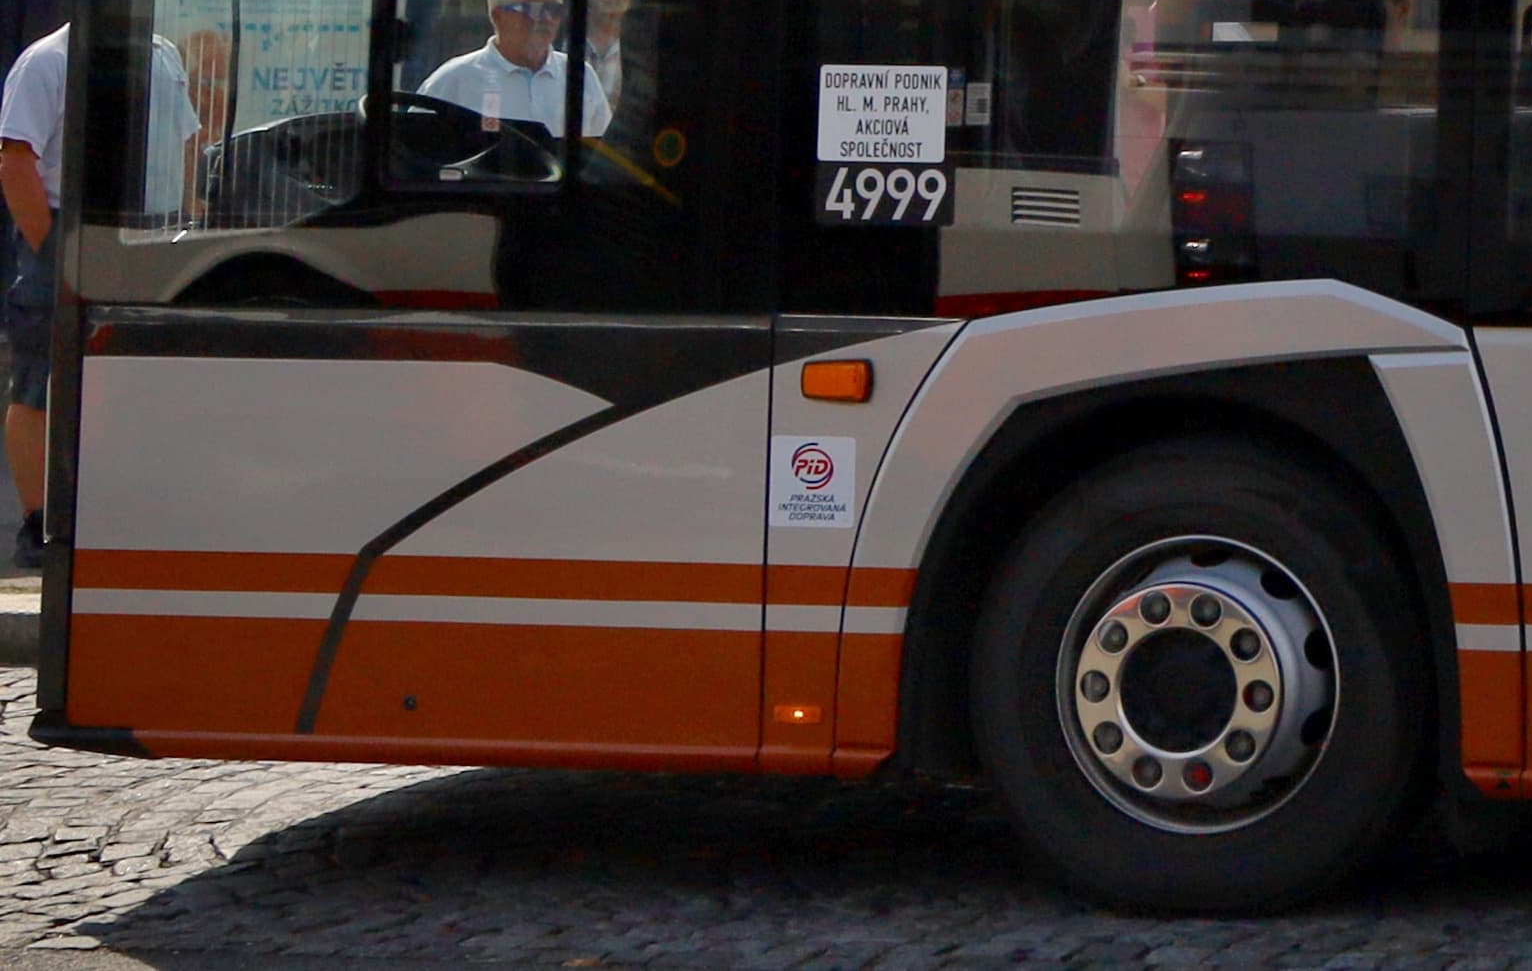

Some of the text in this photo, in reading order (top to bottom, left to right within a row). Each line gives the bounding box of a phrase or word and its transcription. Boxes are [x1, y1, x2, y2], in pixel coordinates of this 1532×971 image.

[252, 63, 368, 91] NEJVĚT
[825, 70, 891, 90] DOPRAVNÍ
[894, 72, 942, 91] PODNIK
[837, 96, 929, 114] HL. M. PRAHY,
[855, 116, 909, 135] AKCIOVÁ
[840, 139, 923, 159] SPOLEČNOST
[825, 166, 947, 221] 4999
[788, 512, 835, 521] DOPRAVA
